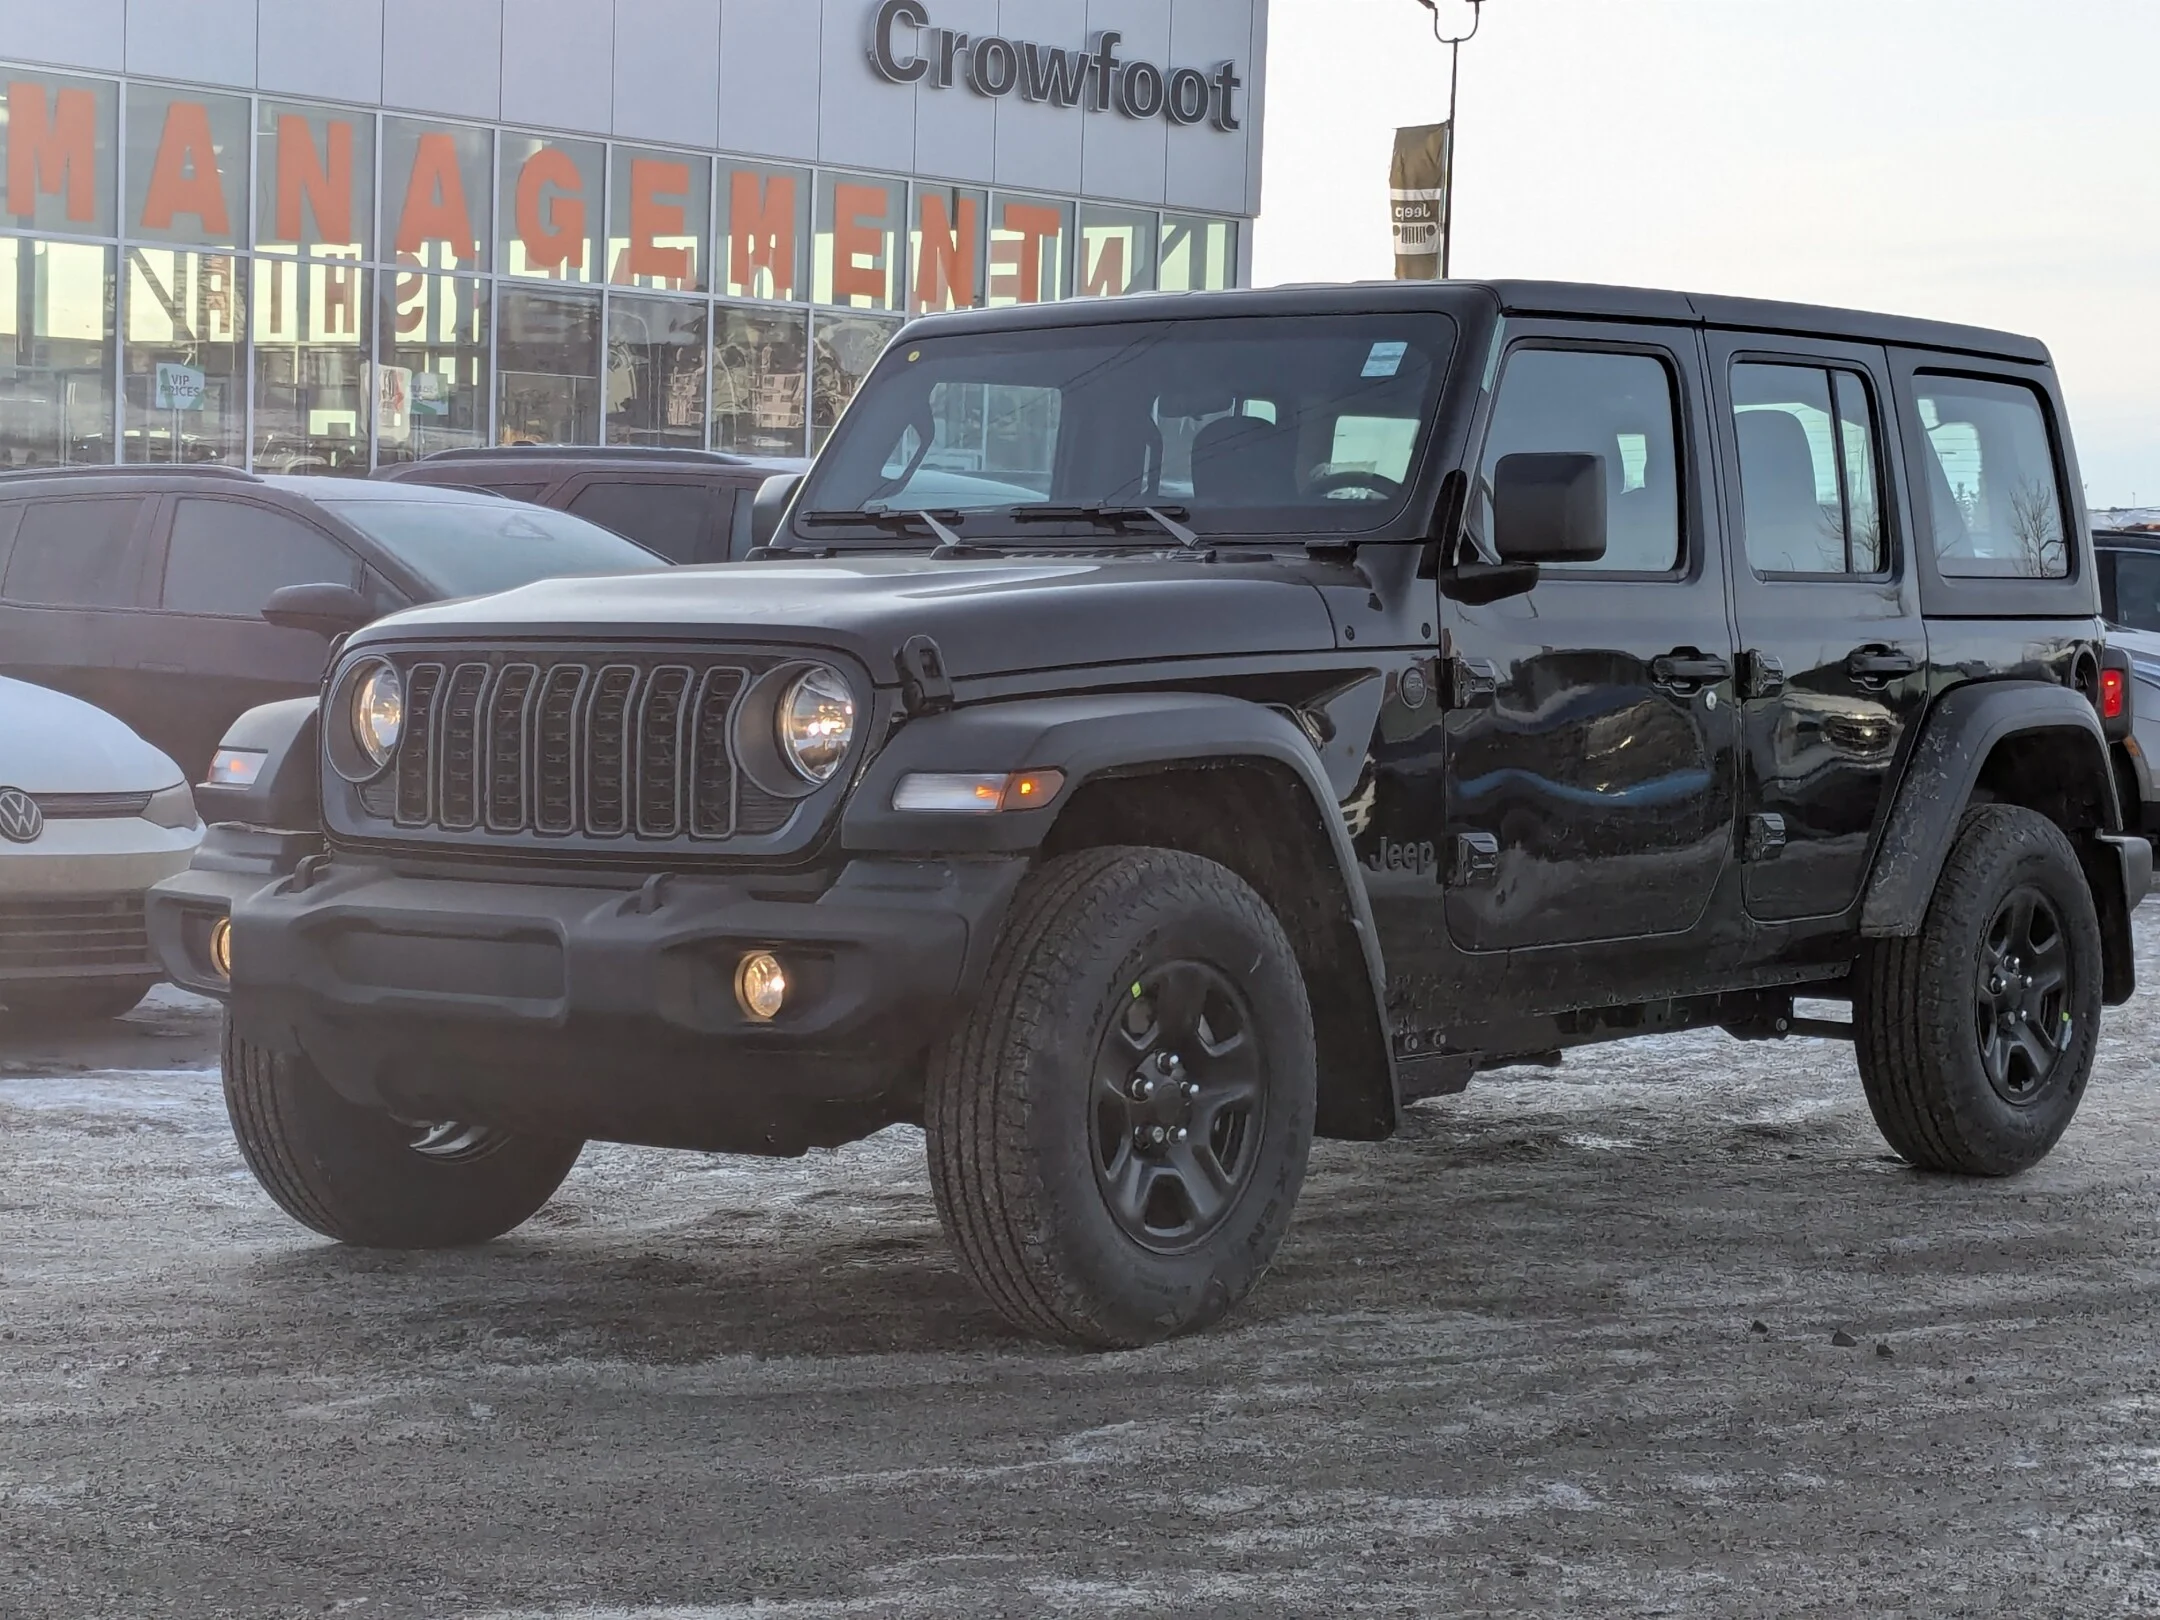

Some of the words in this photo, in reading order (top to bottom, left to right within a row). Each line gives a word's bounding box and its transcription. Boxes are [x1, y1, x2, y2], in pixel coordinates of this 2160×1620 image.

[871, 0, 1241, 132] Crowfoot
[6, 80, 1061, 308] MANAGEMENT
[171, 374, 189, 385] VIP
[1369, 836, 1435, 876] Jeep
